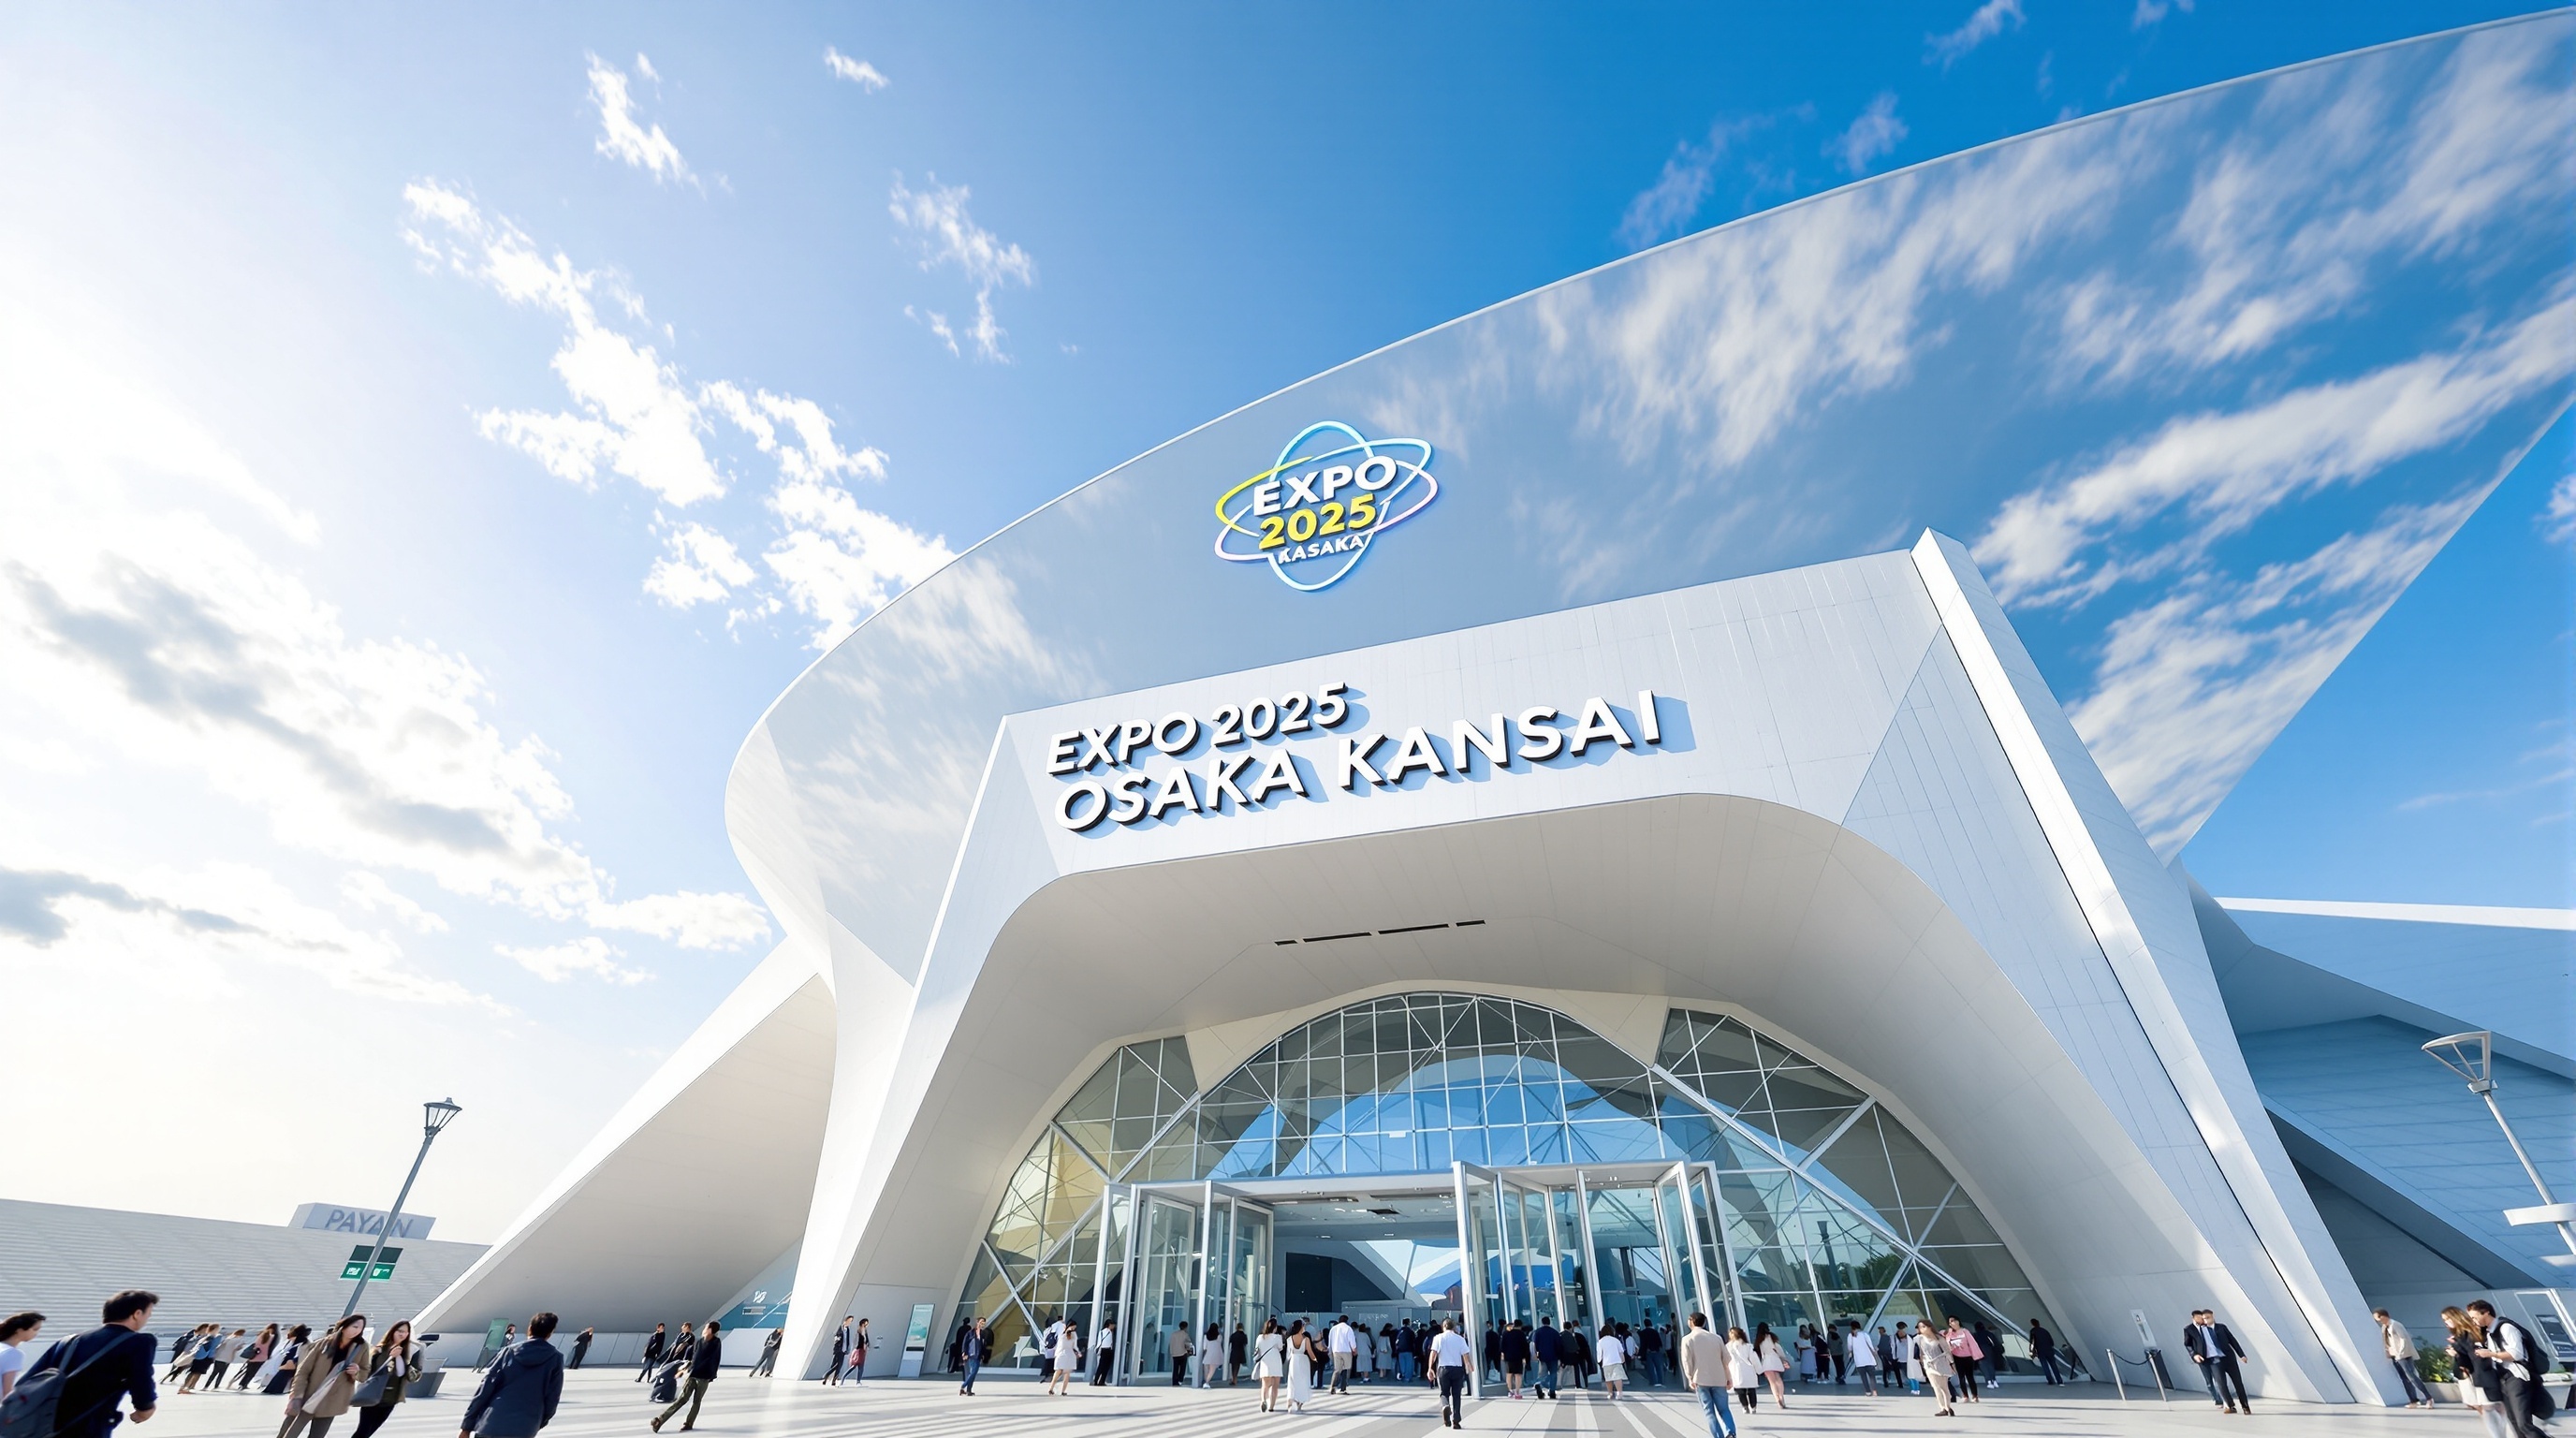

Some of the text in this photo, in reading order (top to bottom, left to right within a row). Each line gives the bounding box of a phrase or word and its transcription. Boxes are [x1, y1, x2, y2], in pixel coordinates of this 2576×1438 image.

[1253, 455, 1398, 516] EXPO
[1258, 493, 1377, 550] 2025
[1046, 682, 1350, 775] EXPO 2025
[1054, 689, 1661, 832] OSAKA KANSAI
